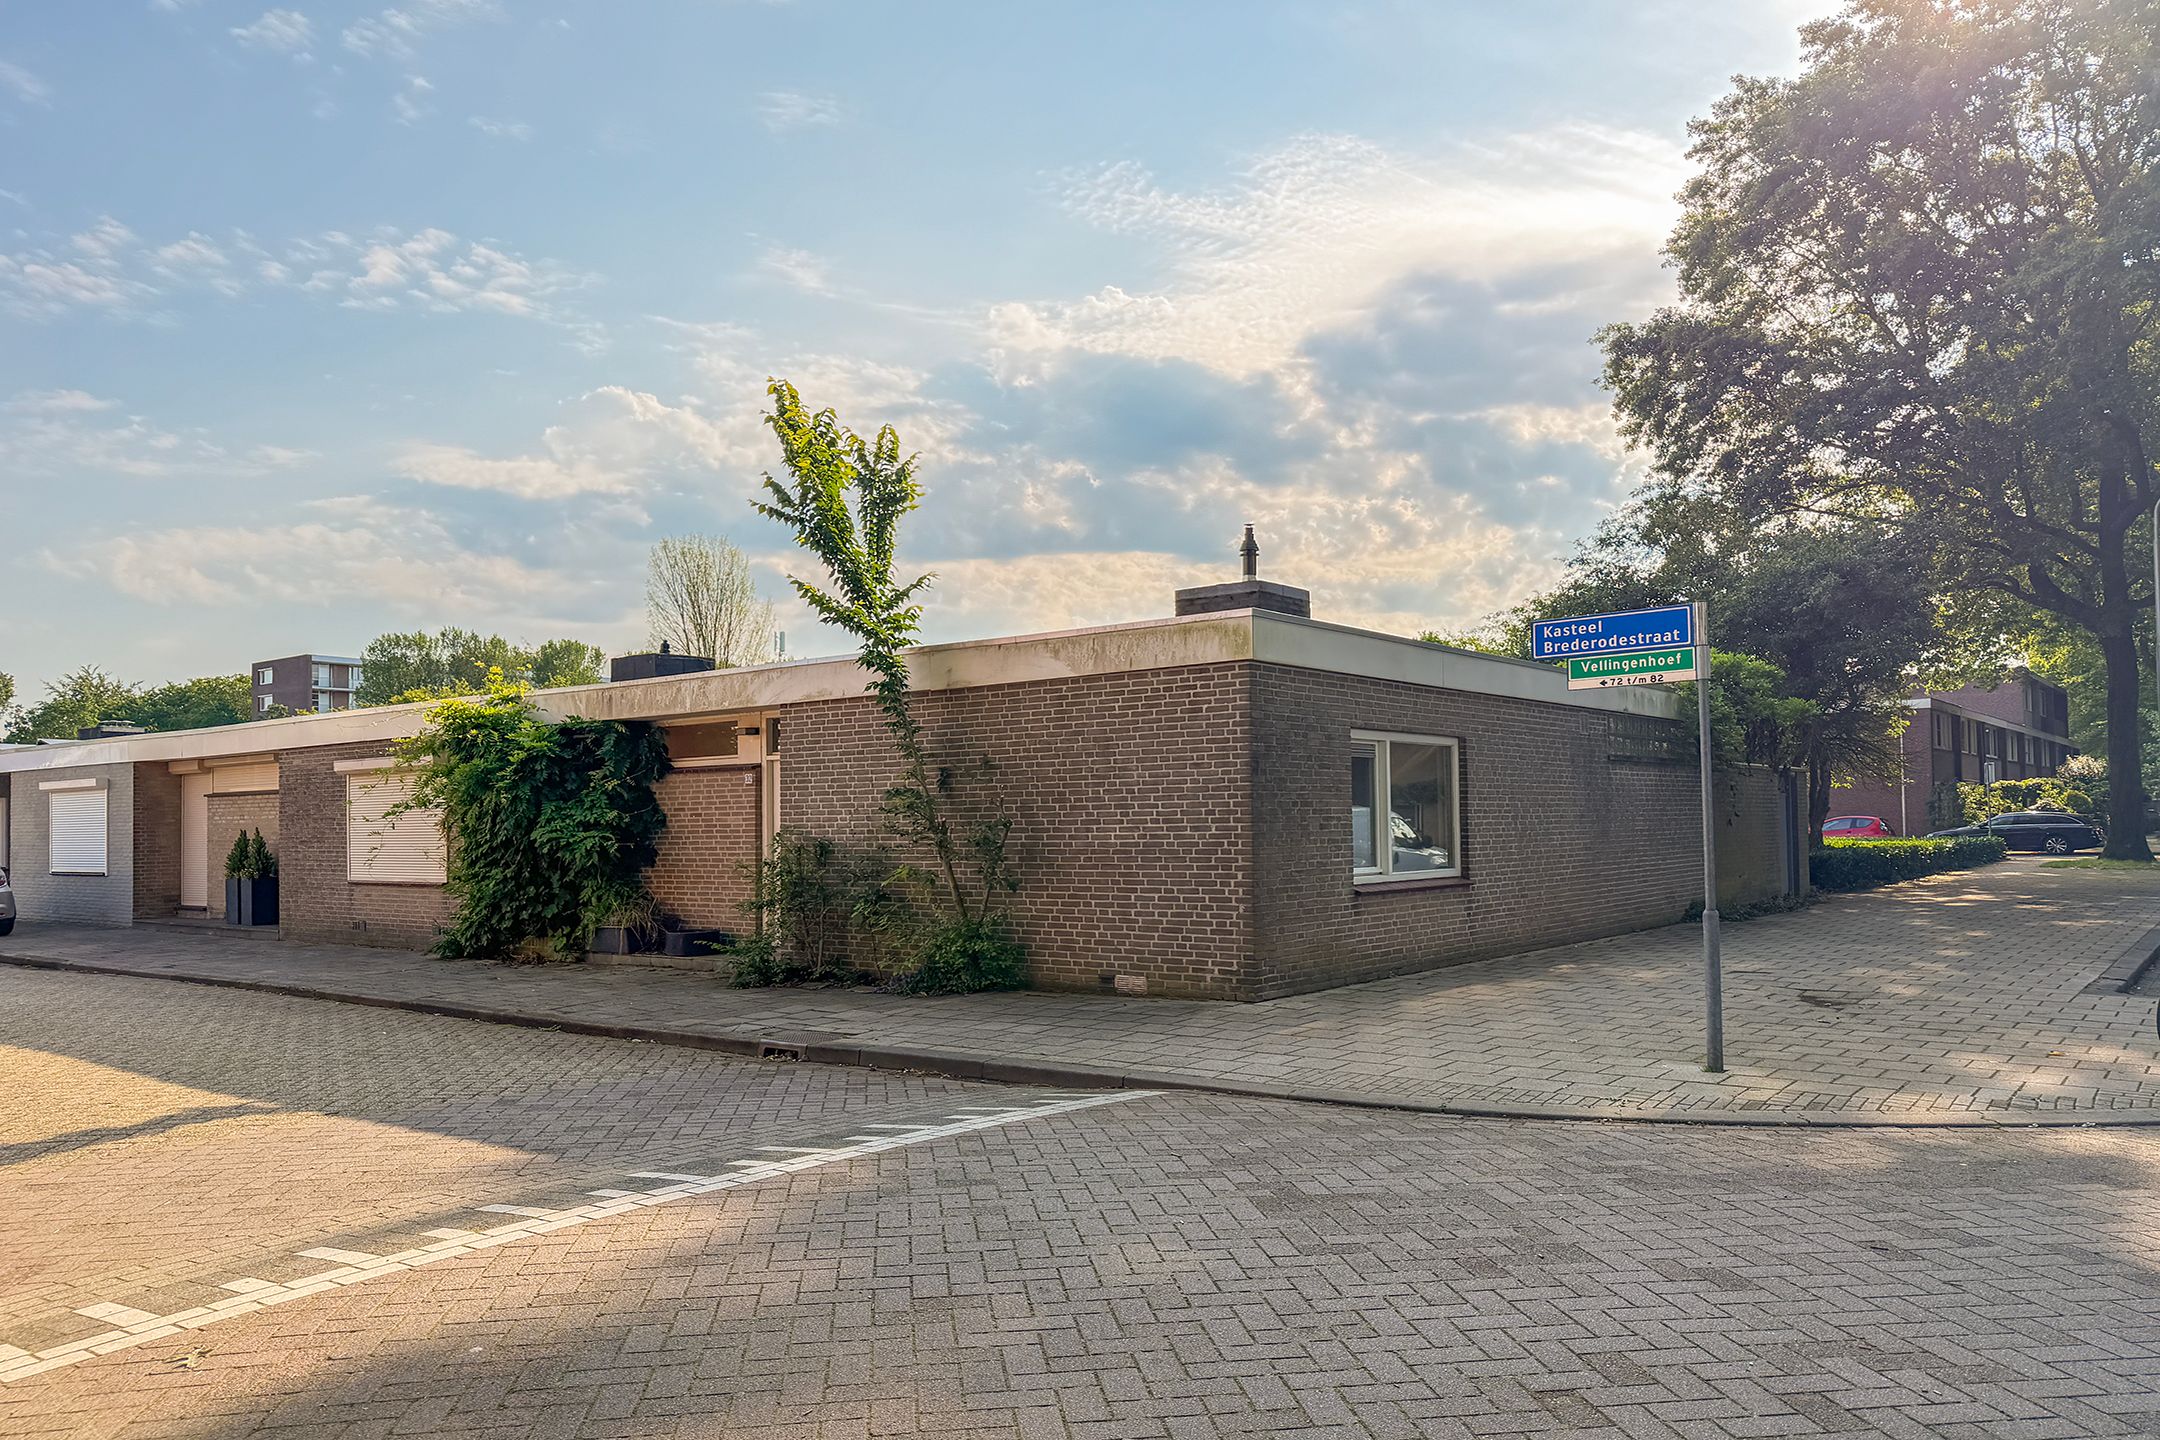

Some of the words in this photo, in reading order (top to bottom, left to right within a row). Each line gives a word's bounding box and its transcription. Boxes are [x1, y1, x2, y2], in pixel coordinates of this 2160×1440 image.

[1543, 620, 1603, 638] Kasteel
[1544, 629, 1681, 654] Brederodestraat
[1581, 652, 1682, 673] Vellingenhoef
[1609, 677, 1624, 687] 72
[1627, 675, 1647, 685] t/m
[1649, 673, 1664, 684] 82
